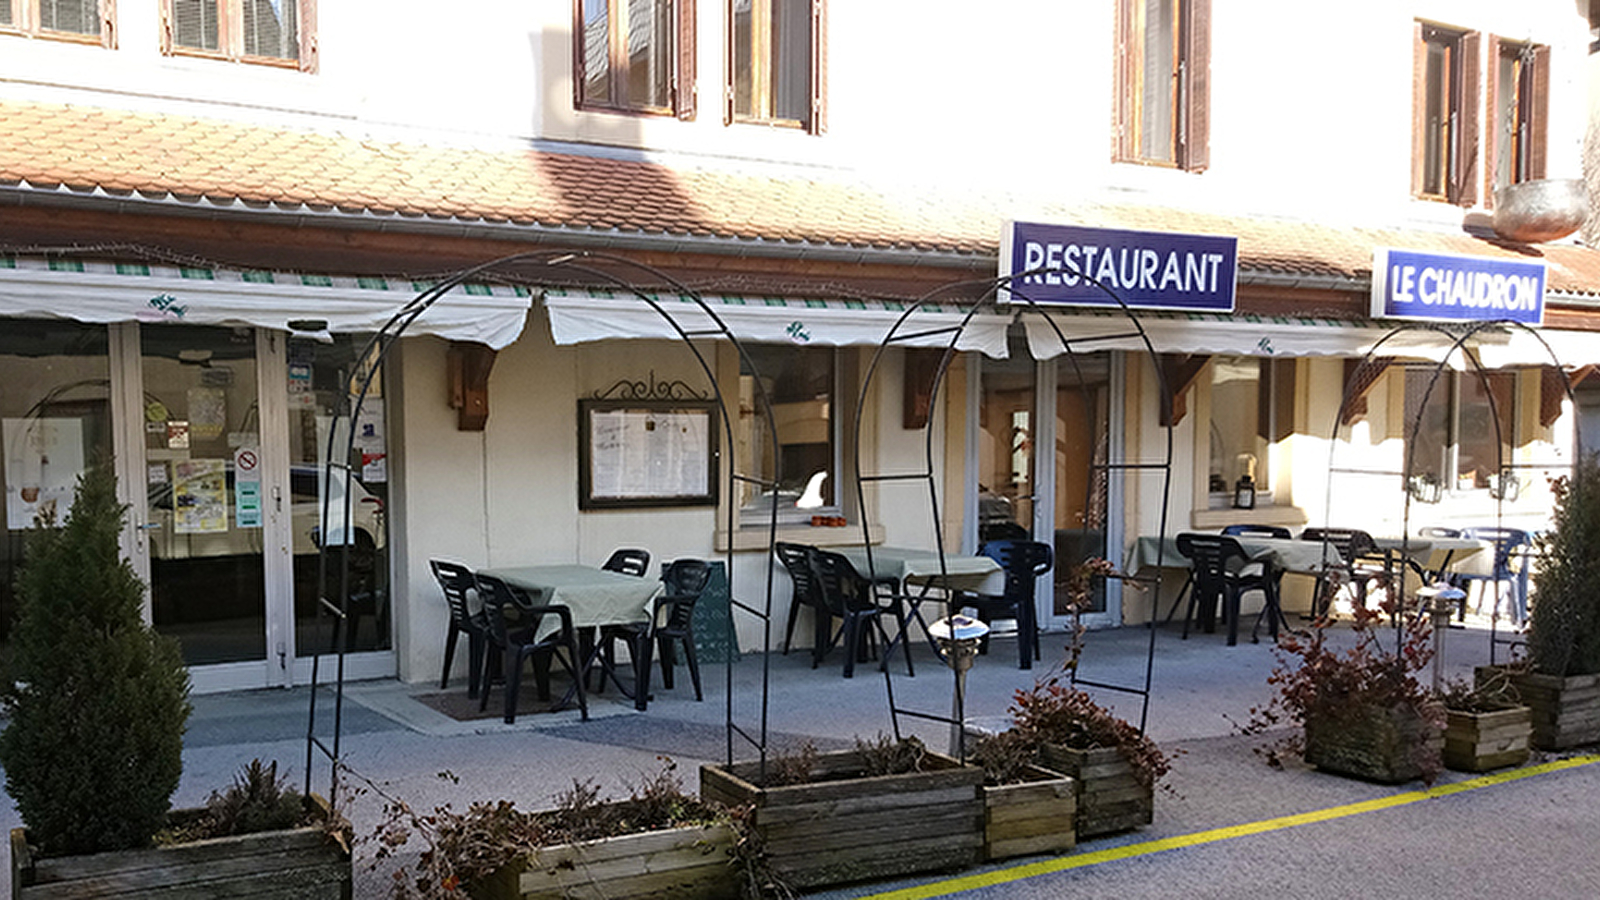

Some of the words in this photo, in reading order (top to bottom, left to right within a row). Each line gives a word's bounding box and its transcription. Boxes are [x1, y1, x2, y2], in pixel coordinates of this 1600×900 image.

[1023, 242, 1224, 292] RESTAURANT
[1392, 265, 1416, 302] LE
[1418, 267, 1538, 311] CHAUDRON
